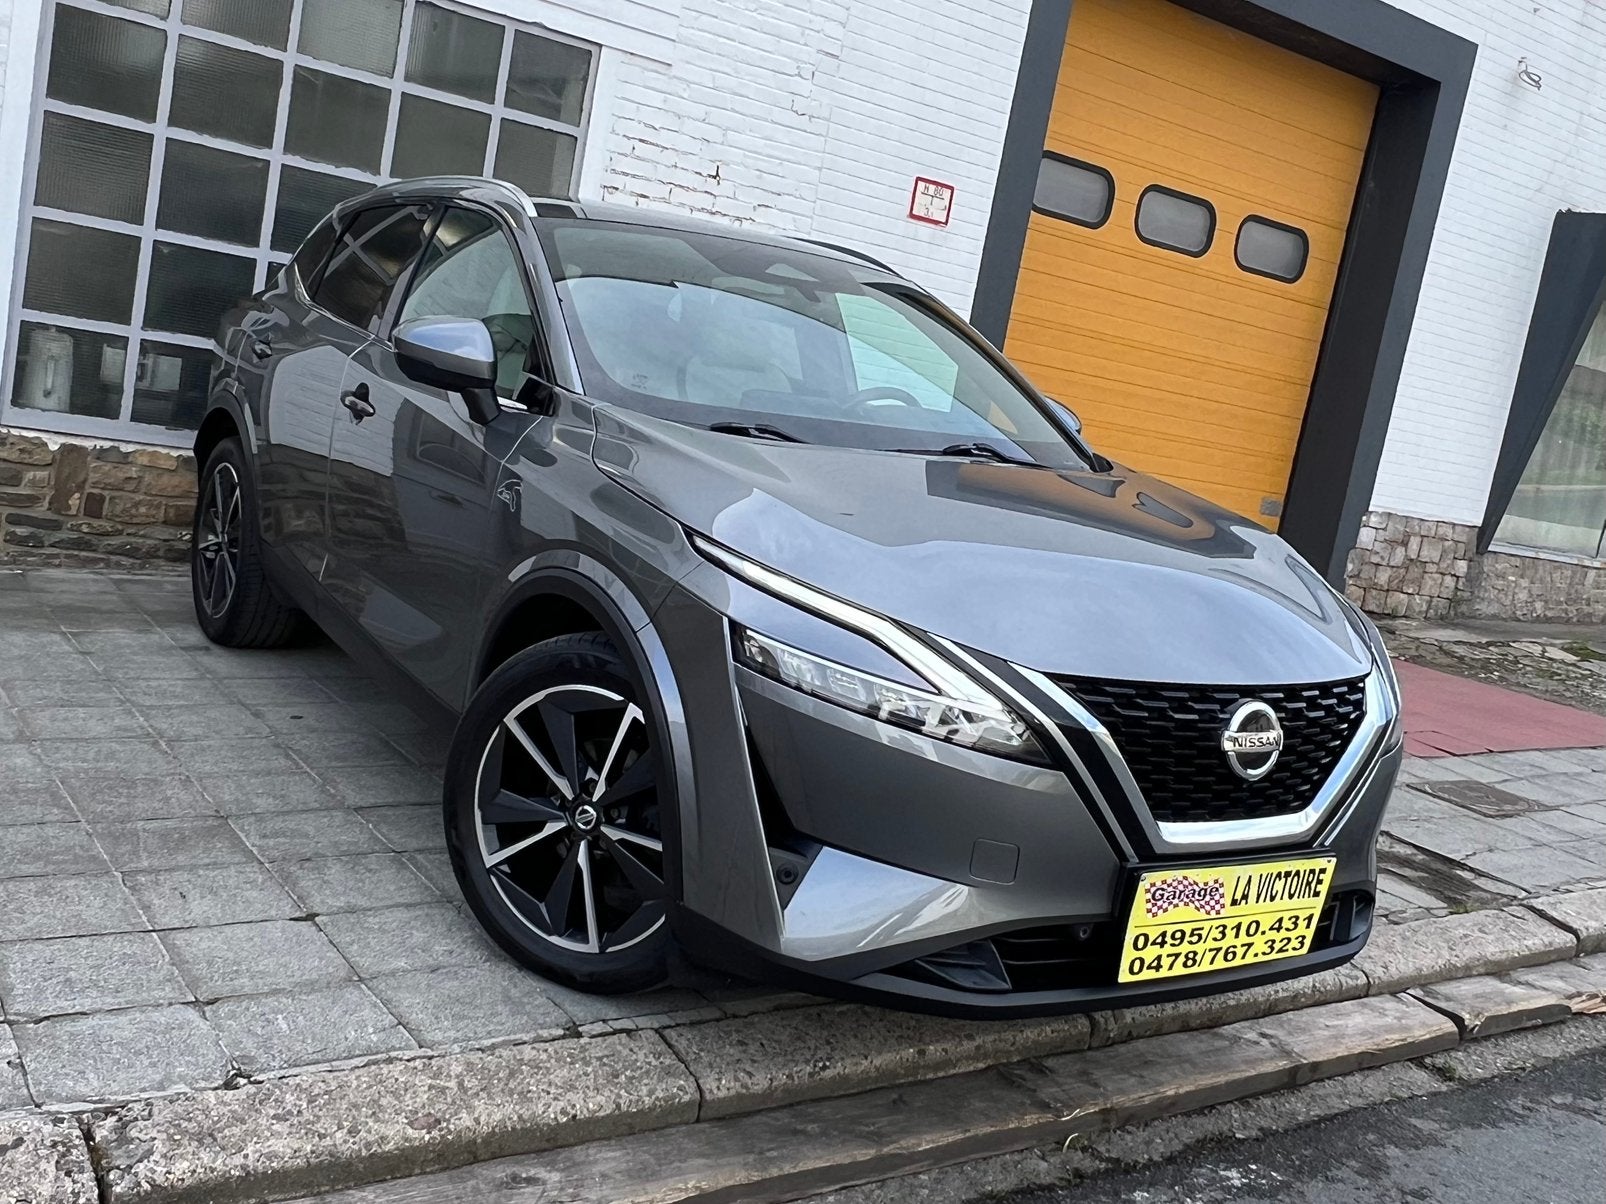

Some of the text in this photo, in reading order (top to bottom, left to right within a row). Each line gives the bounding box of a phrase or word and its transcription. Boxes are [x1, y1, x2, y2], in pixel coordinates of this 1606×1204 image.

[1232, 736, 1280, 748] NISSAN
[1151, 867, 1327, 907] Garage LA VICTOIRE
[1132, 912, 1315, 952] 0495/310.431
[1128, 934, 1307, 976] 0478/767.323
